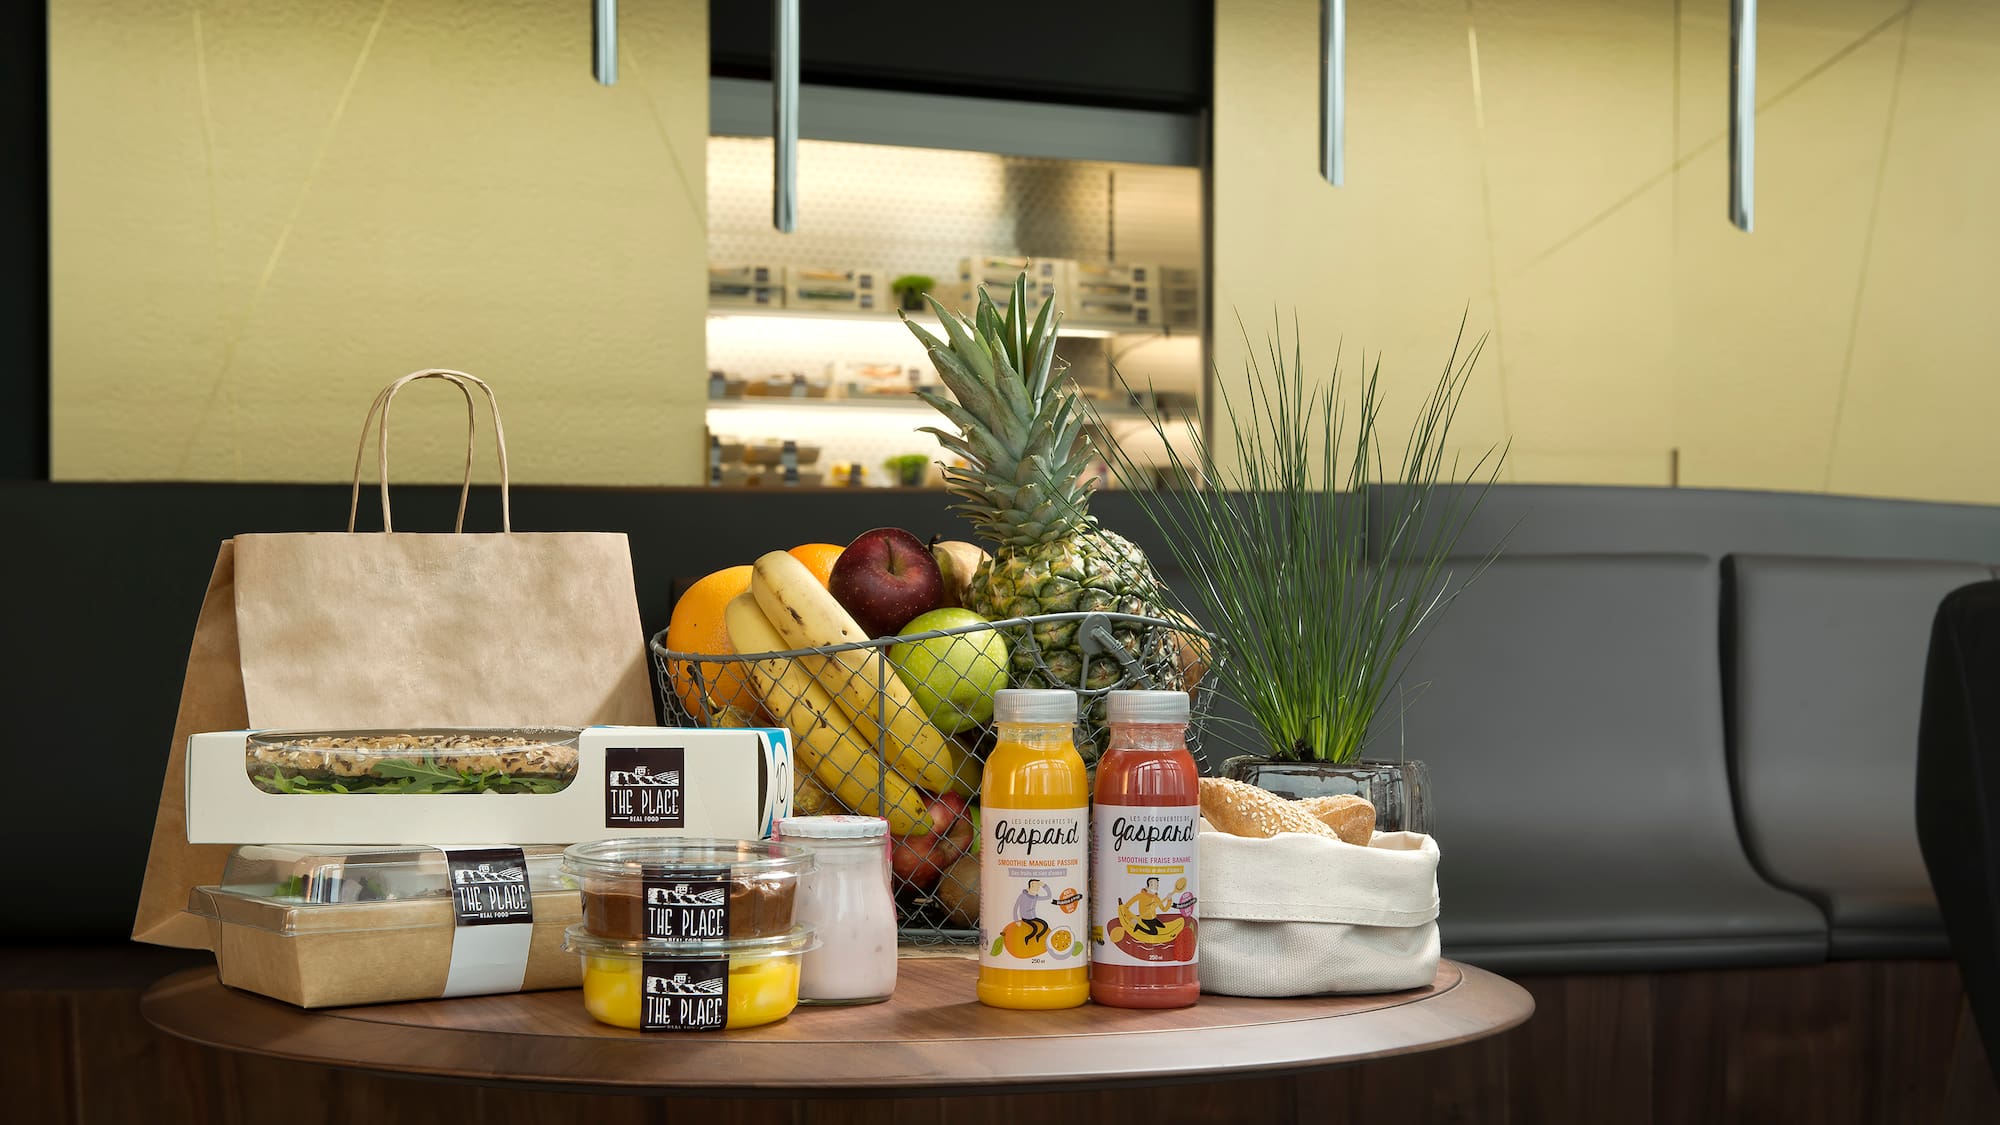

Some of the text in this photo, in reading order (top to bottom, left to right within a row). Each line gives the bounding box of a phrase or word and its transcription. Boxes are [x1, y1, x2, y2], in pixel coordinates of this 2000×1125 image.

[610, 789, 679, 814] THE PLACE
[998, 859, 1027, 867] SMOOTHIE
[1117, 856, 1148, 864] SMOOTHIE
[458, 884, 527, 911] THE PLACE
[648, 907, 724, 937] THE PLACE
[647, 996, 722, 1025] THE PLACE
